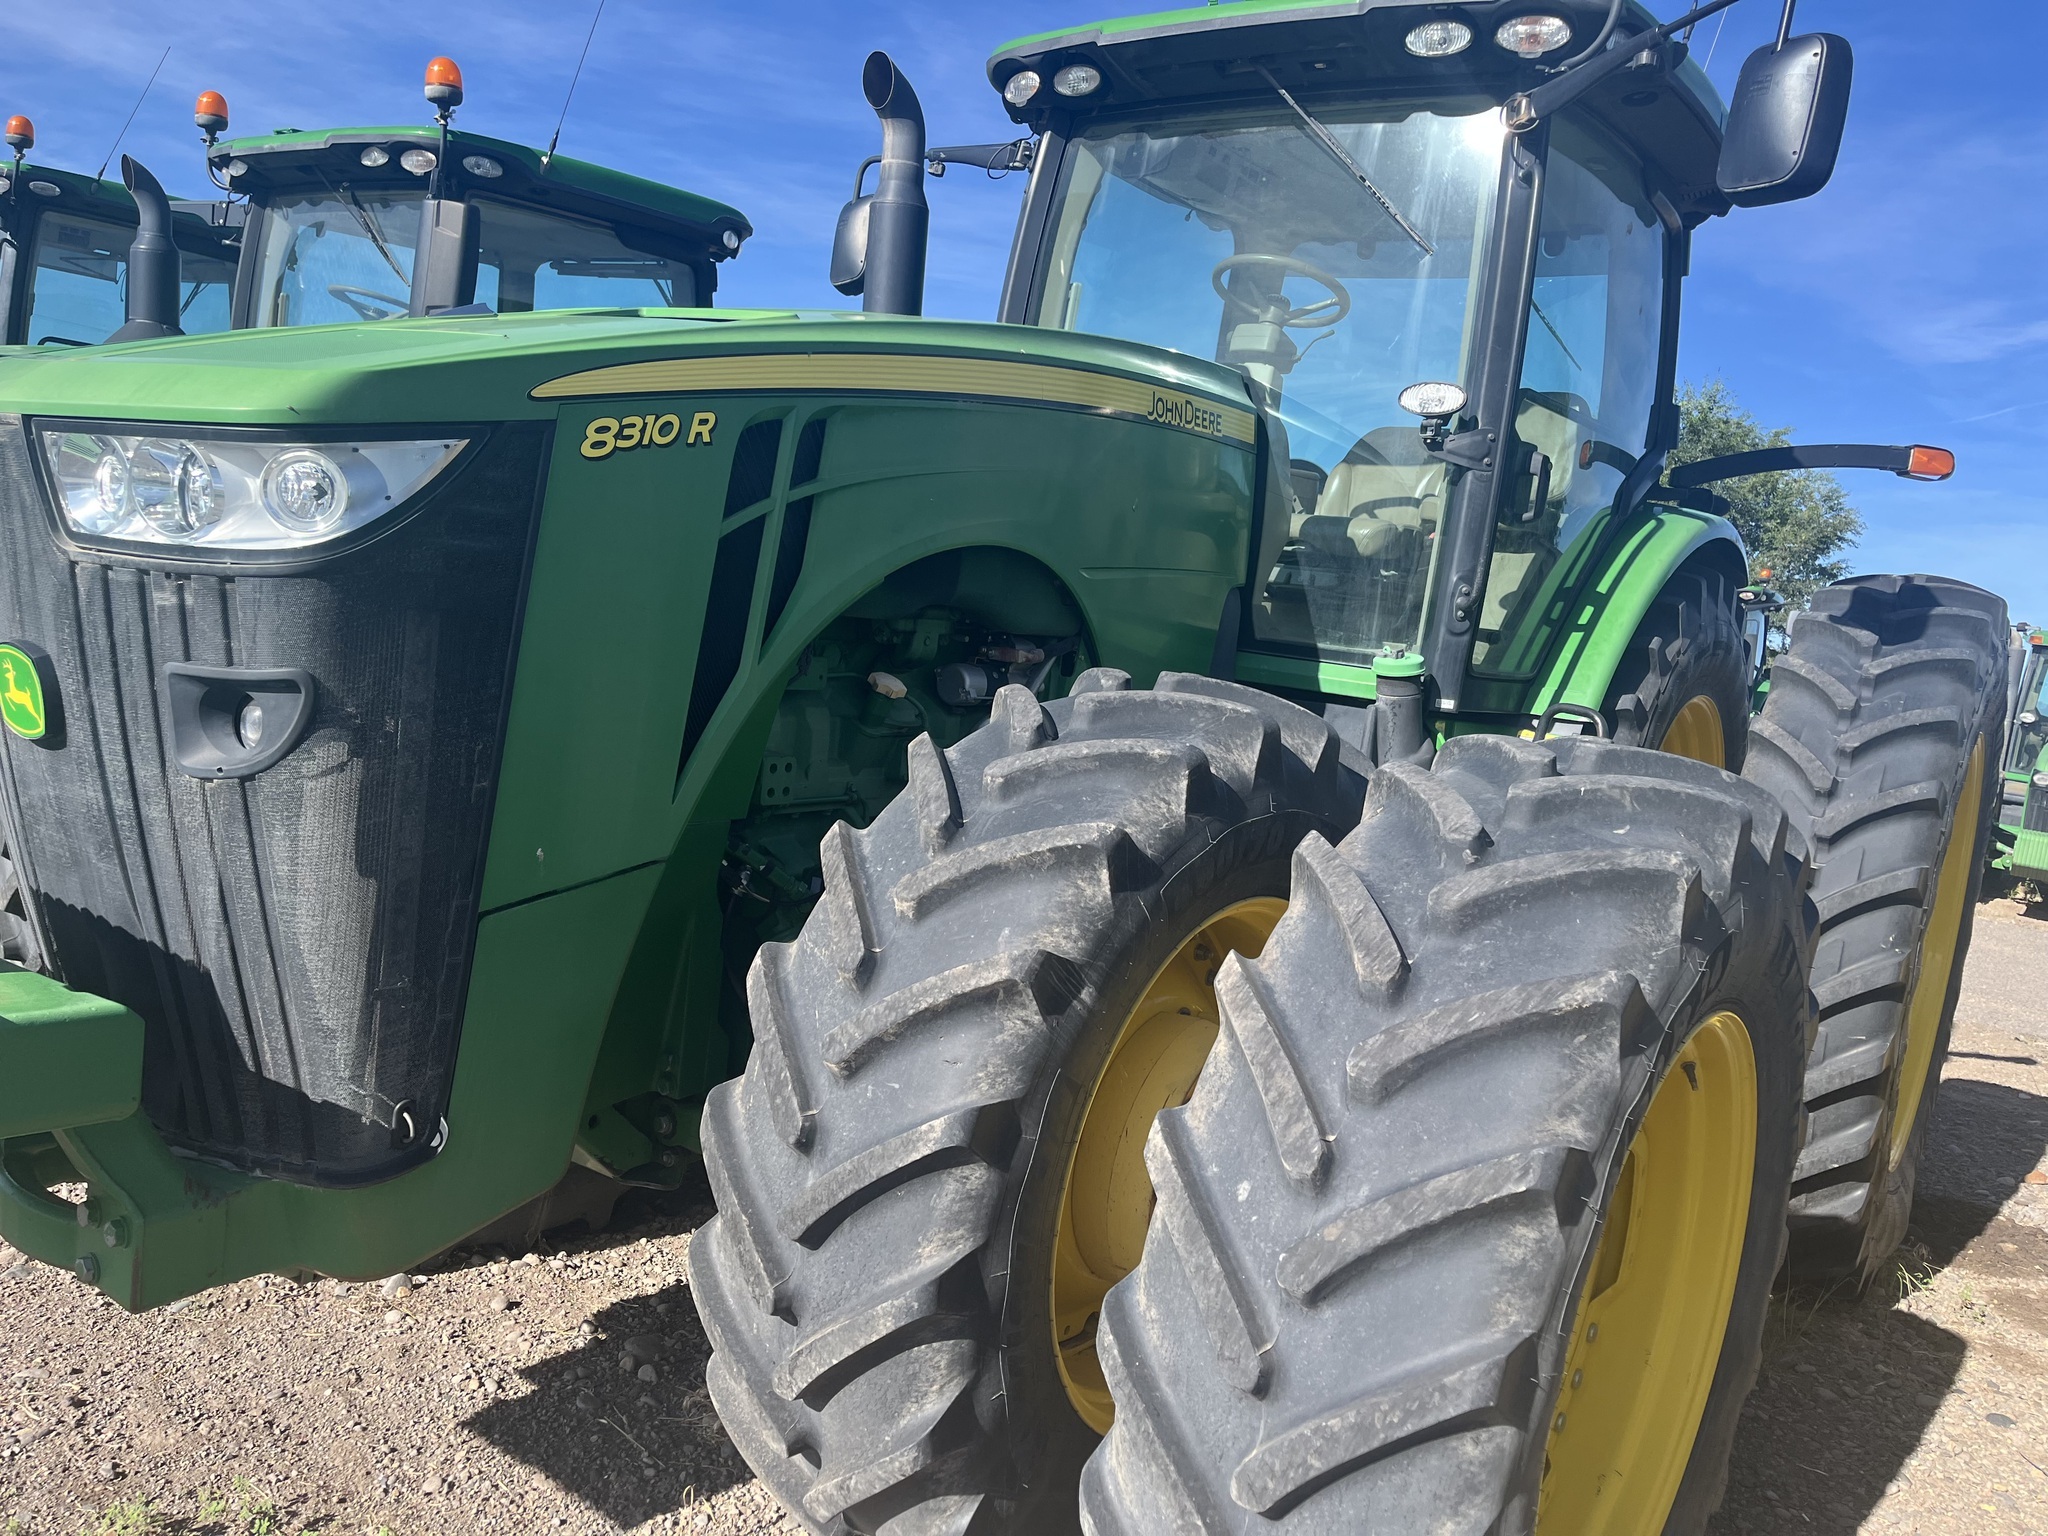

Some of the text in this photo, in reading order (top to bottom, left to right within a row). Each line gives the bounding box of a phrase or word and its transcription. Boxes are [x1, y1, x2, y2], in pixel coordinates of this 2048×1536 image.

[580, 411, 718, 460] 8310 R
[1146, 390, 1223, 435] JOHN DEERE
